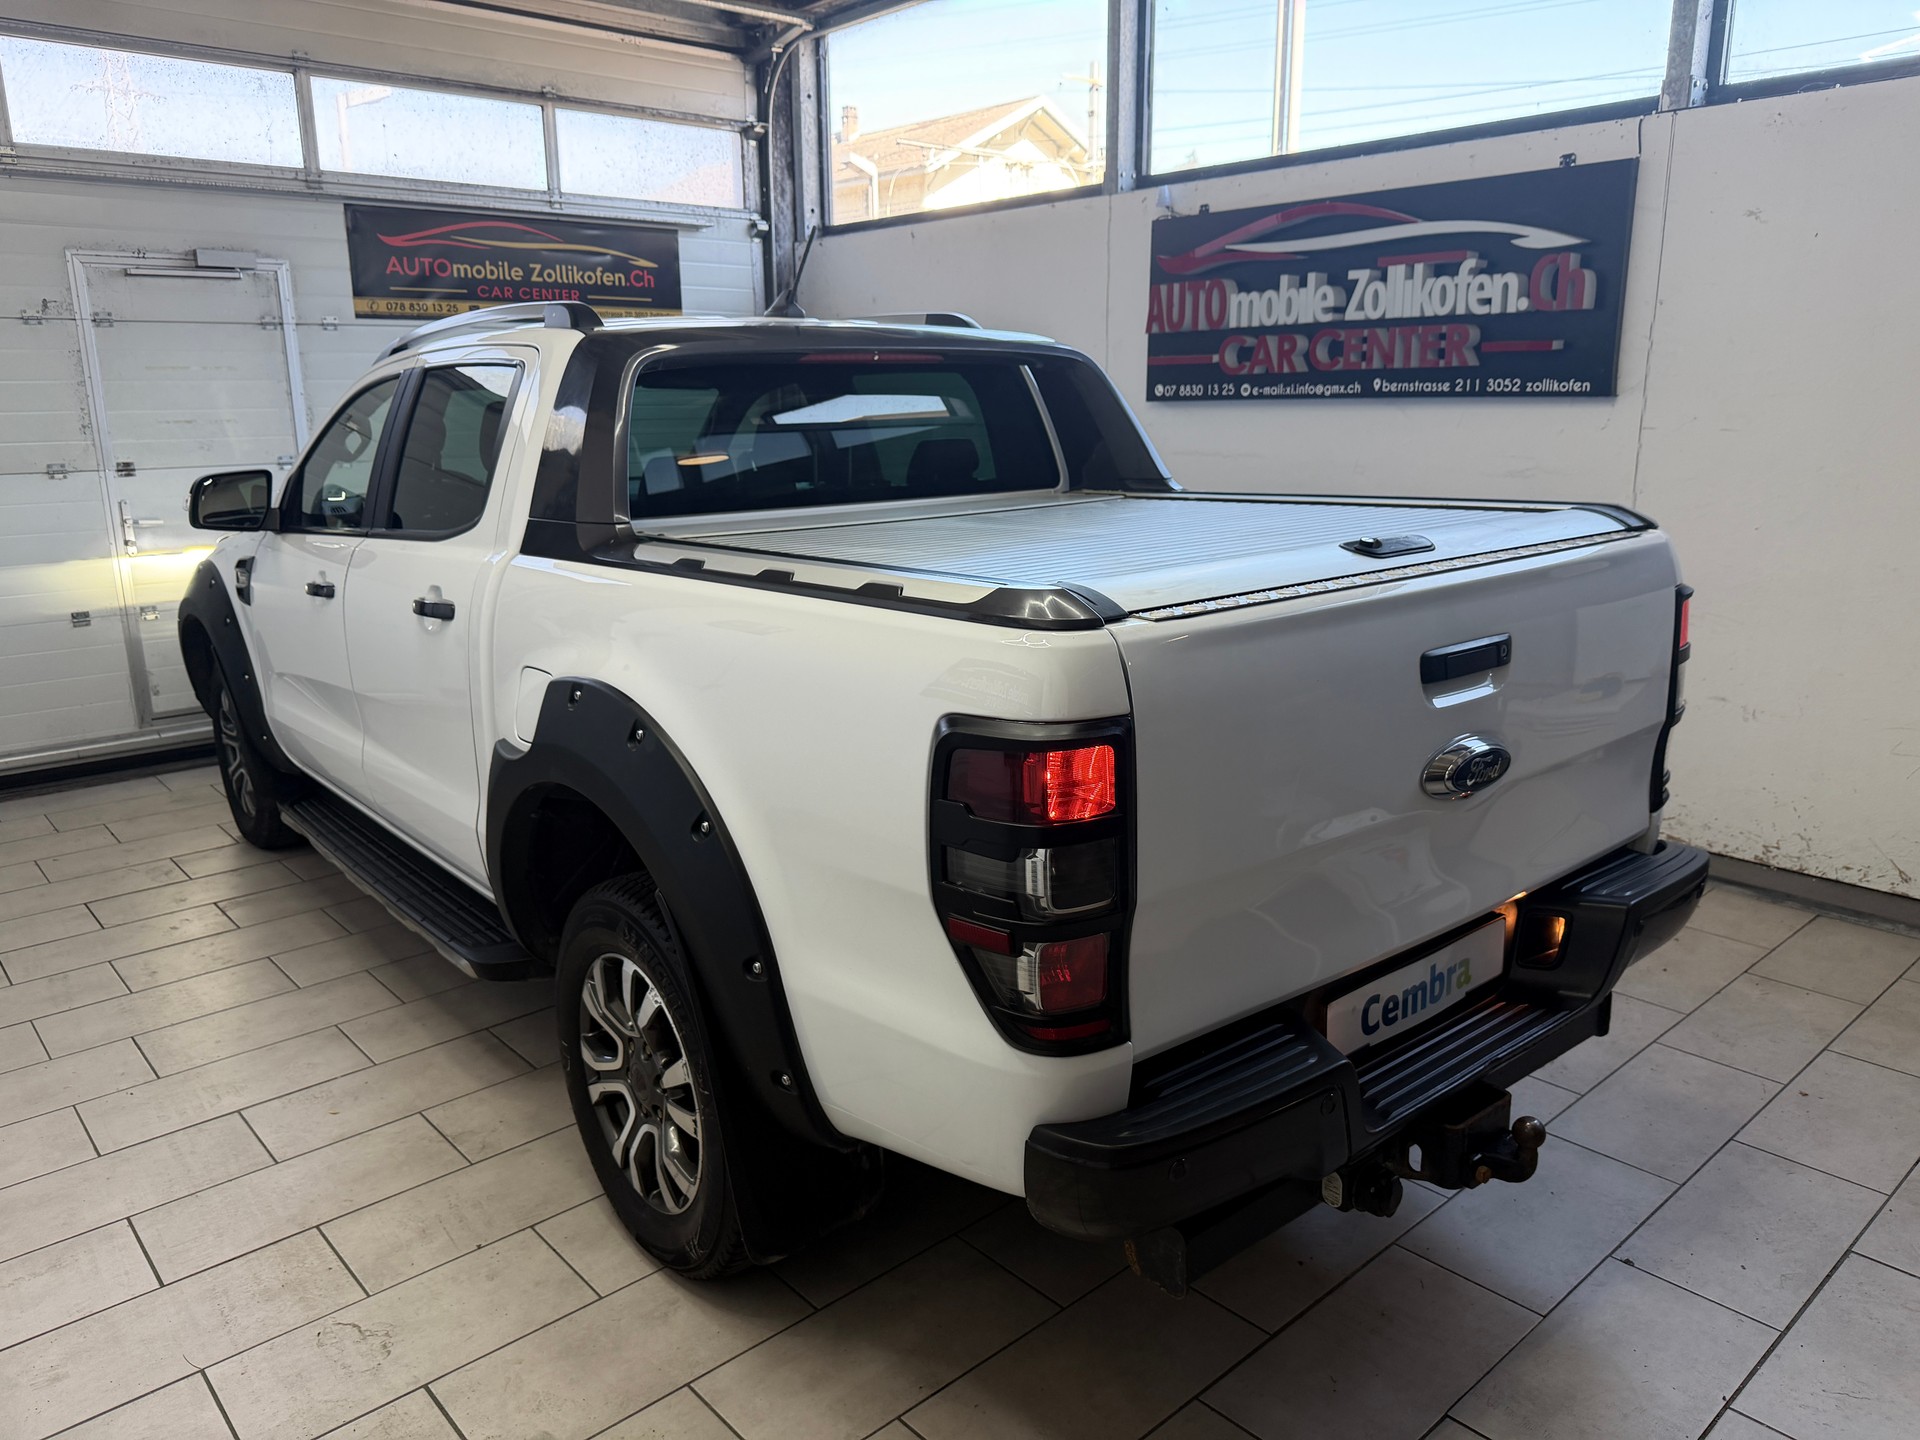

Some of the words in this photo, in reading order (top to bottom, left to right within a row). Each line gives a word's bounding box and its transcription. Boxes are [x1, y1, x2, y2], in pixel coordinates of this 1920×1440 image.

[386, 256, 524, 281] AUTOmobile
[529, 263, 655, 288] Zollikofen.Ch
[408, 302, 429, 313] 830
[432, 303, 443, 313] 13
[446, 303, 459, 313] 25
[477, 285, 513, 299] CAR
[519, 287, 580, 301] CENTER
[1146, 271, 1338, 334] AUTOmobile
[1344, 252, 1592, 321] Zollikofen.Ch
[1219, 334, 1306, 375] CAR
[1309, 323, 1476, 373] CENTER
[1164, 385, 1177, 396] 07
[1178, 384, 1204, 397] 8830
[1207, 384, 1219, 396] 13
[1222, 383, 1236, 395] 25
[1381, 377, 1451, 392] bernstrasse
[1455, 378, 1480, 392] 211
[1486, 377, 1521, 392] 3052
[1526, 378, 1591, 392] zollikofen
[1466, 755, 1502, 786] Ford
[1361, 958, 1472, 1036] Cembra
